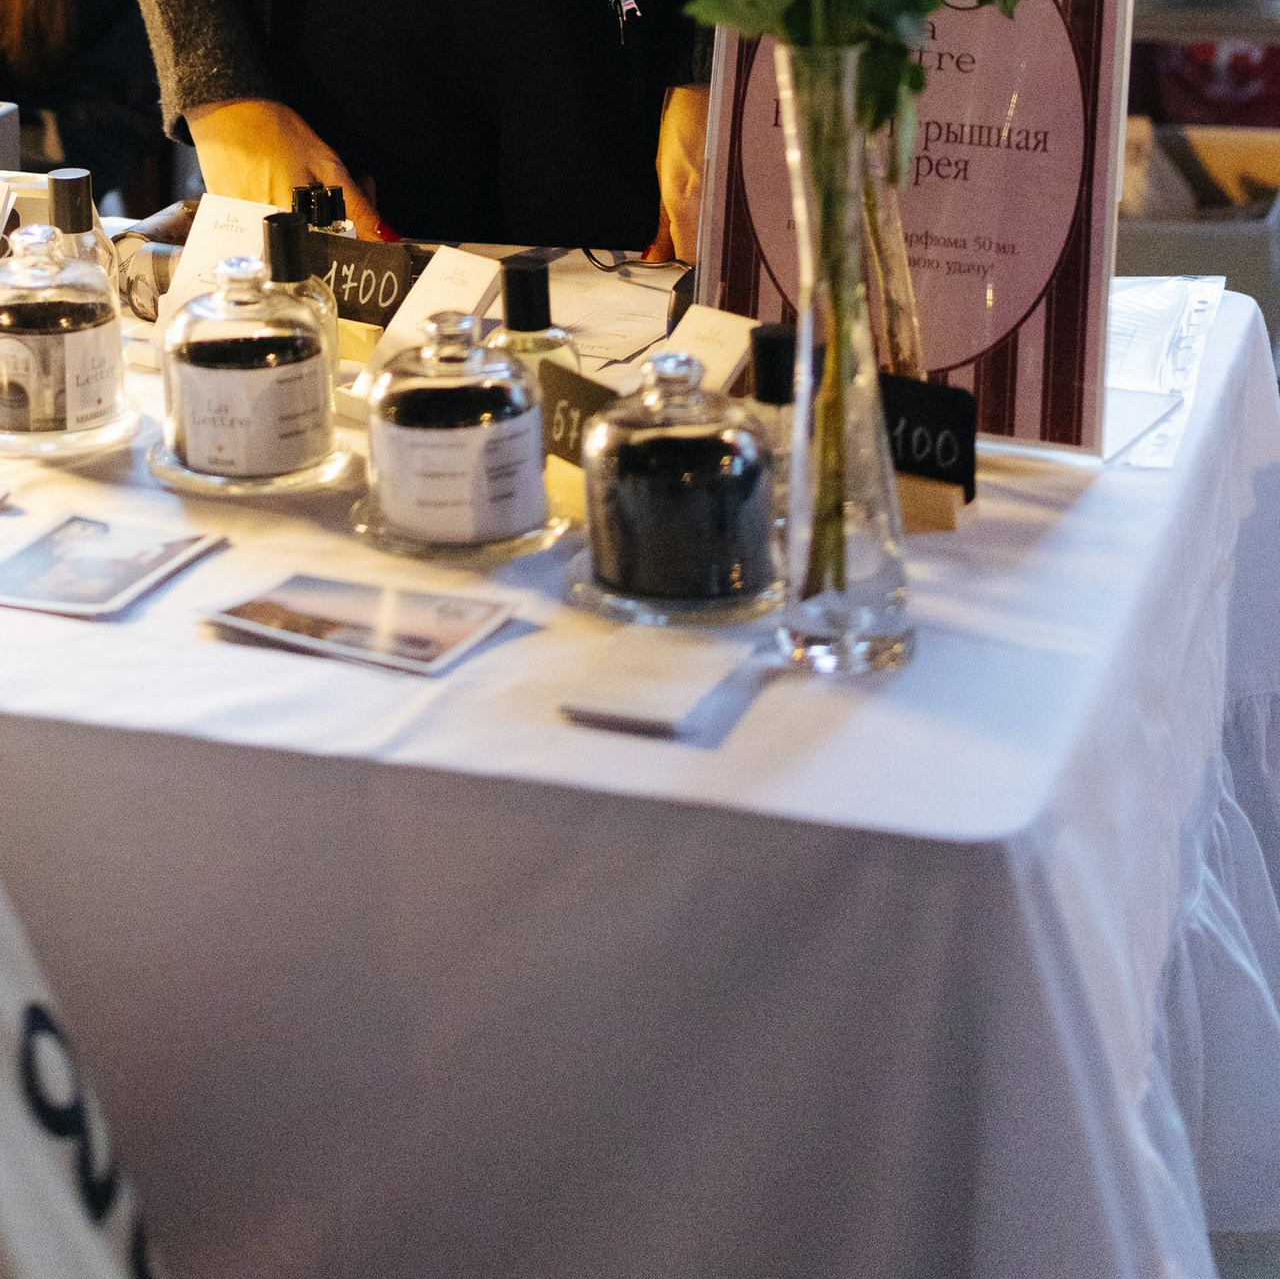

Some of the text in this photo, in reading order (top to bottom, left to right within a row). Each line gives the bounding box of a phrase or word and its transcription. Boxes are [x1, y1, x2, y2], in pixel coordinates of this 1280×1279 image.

[226, 213, 239, 224] La
[214, 220, 247, 234] Lettre
[909, 256, 940, 271] вою
[323, 260, 398, 308] 1700
